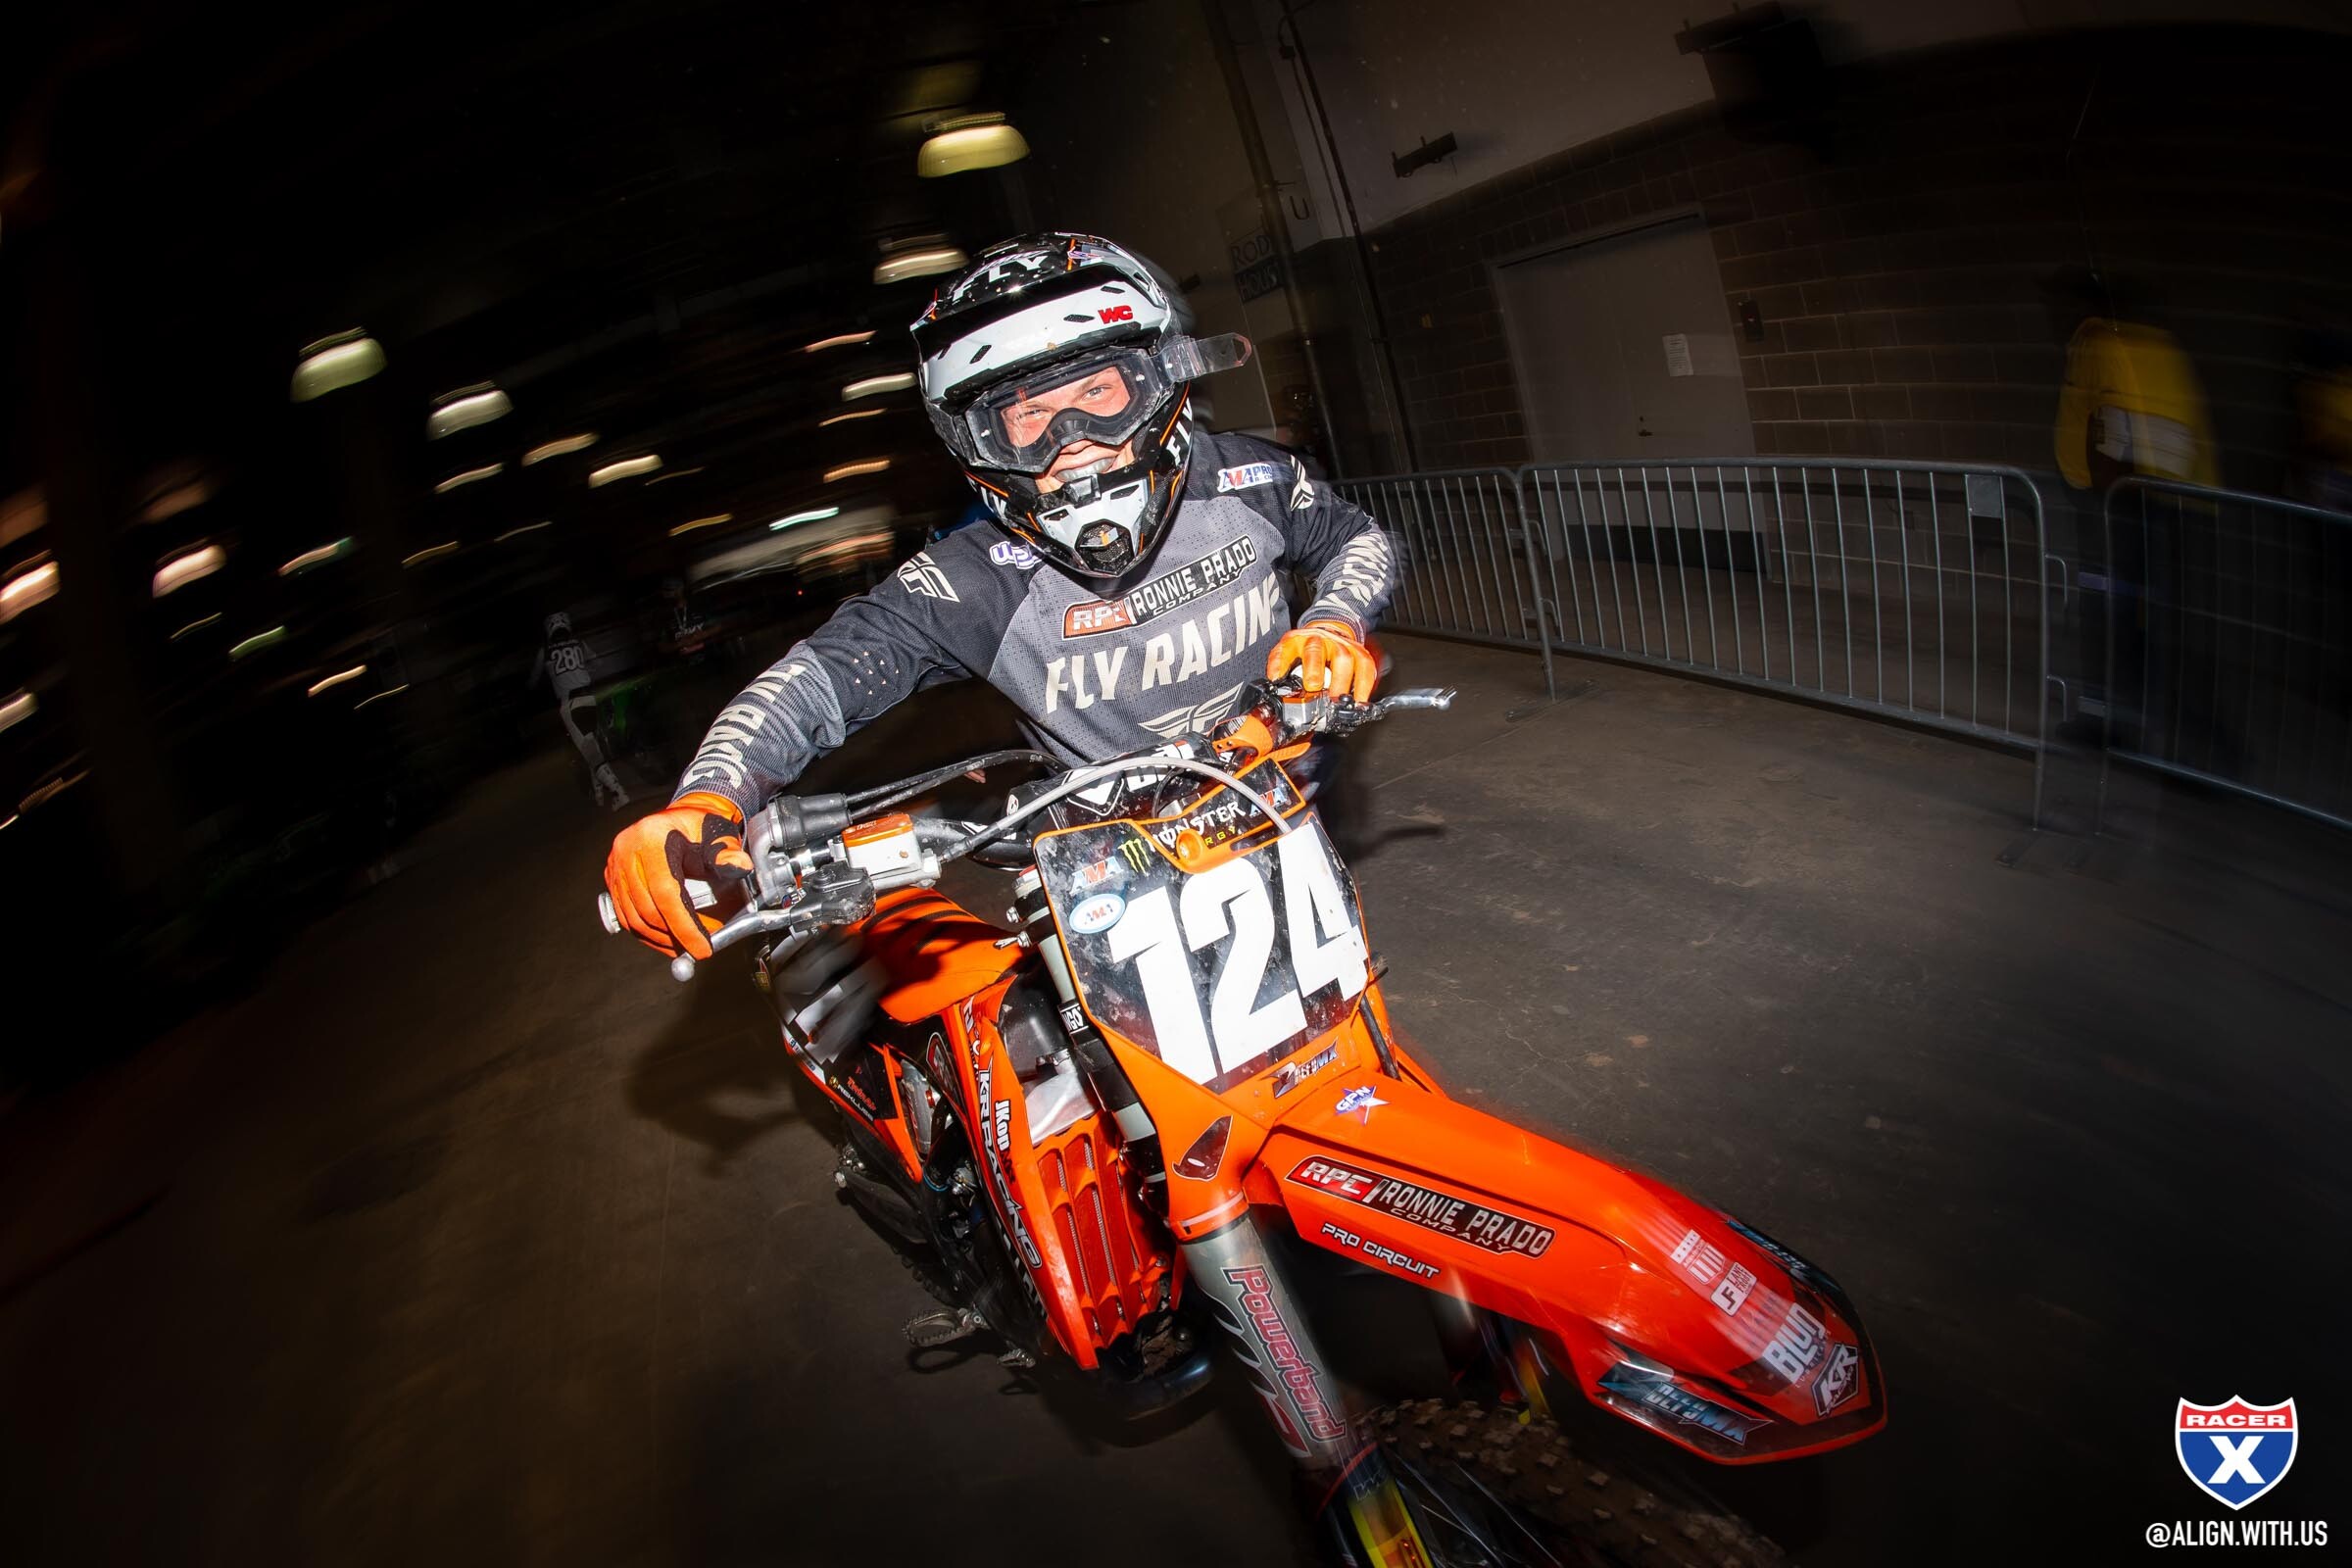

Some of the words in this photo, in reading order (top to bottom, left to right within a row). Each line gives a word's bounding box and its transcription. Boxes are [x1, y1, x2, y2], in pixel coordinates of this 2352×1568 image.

[952, 250, 1049, 302] FLY
[1098, 305, 1133, 324] WC
[1131, 566, 1197, 616] RONNIE
[1200, 537, 1256, 584] PRADO
[1152, 566, 1243, 617] COMPANY
[1045, 646, 1129, 714] FLY
[1069, 856, 1125, 897] AMA
[1107, 821, 1368, 1085] 124
[1336, 1085, 1372, 1111] GPN
[1379, 1180, 1464, 1227] RONNIE
[1468, 1207, 1552, 1256] PRADO
[1389, 1205, 1515, 1253] COMPANY
[1321, 1222, 1361, 1249] PRO
[1361, 1240, 1441, 1279] CIRCUIT
[1221, 1264, 1347, 1444] Powerband
[1762, 1302, 1827, 1384] BLUD
